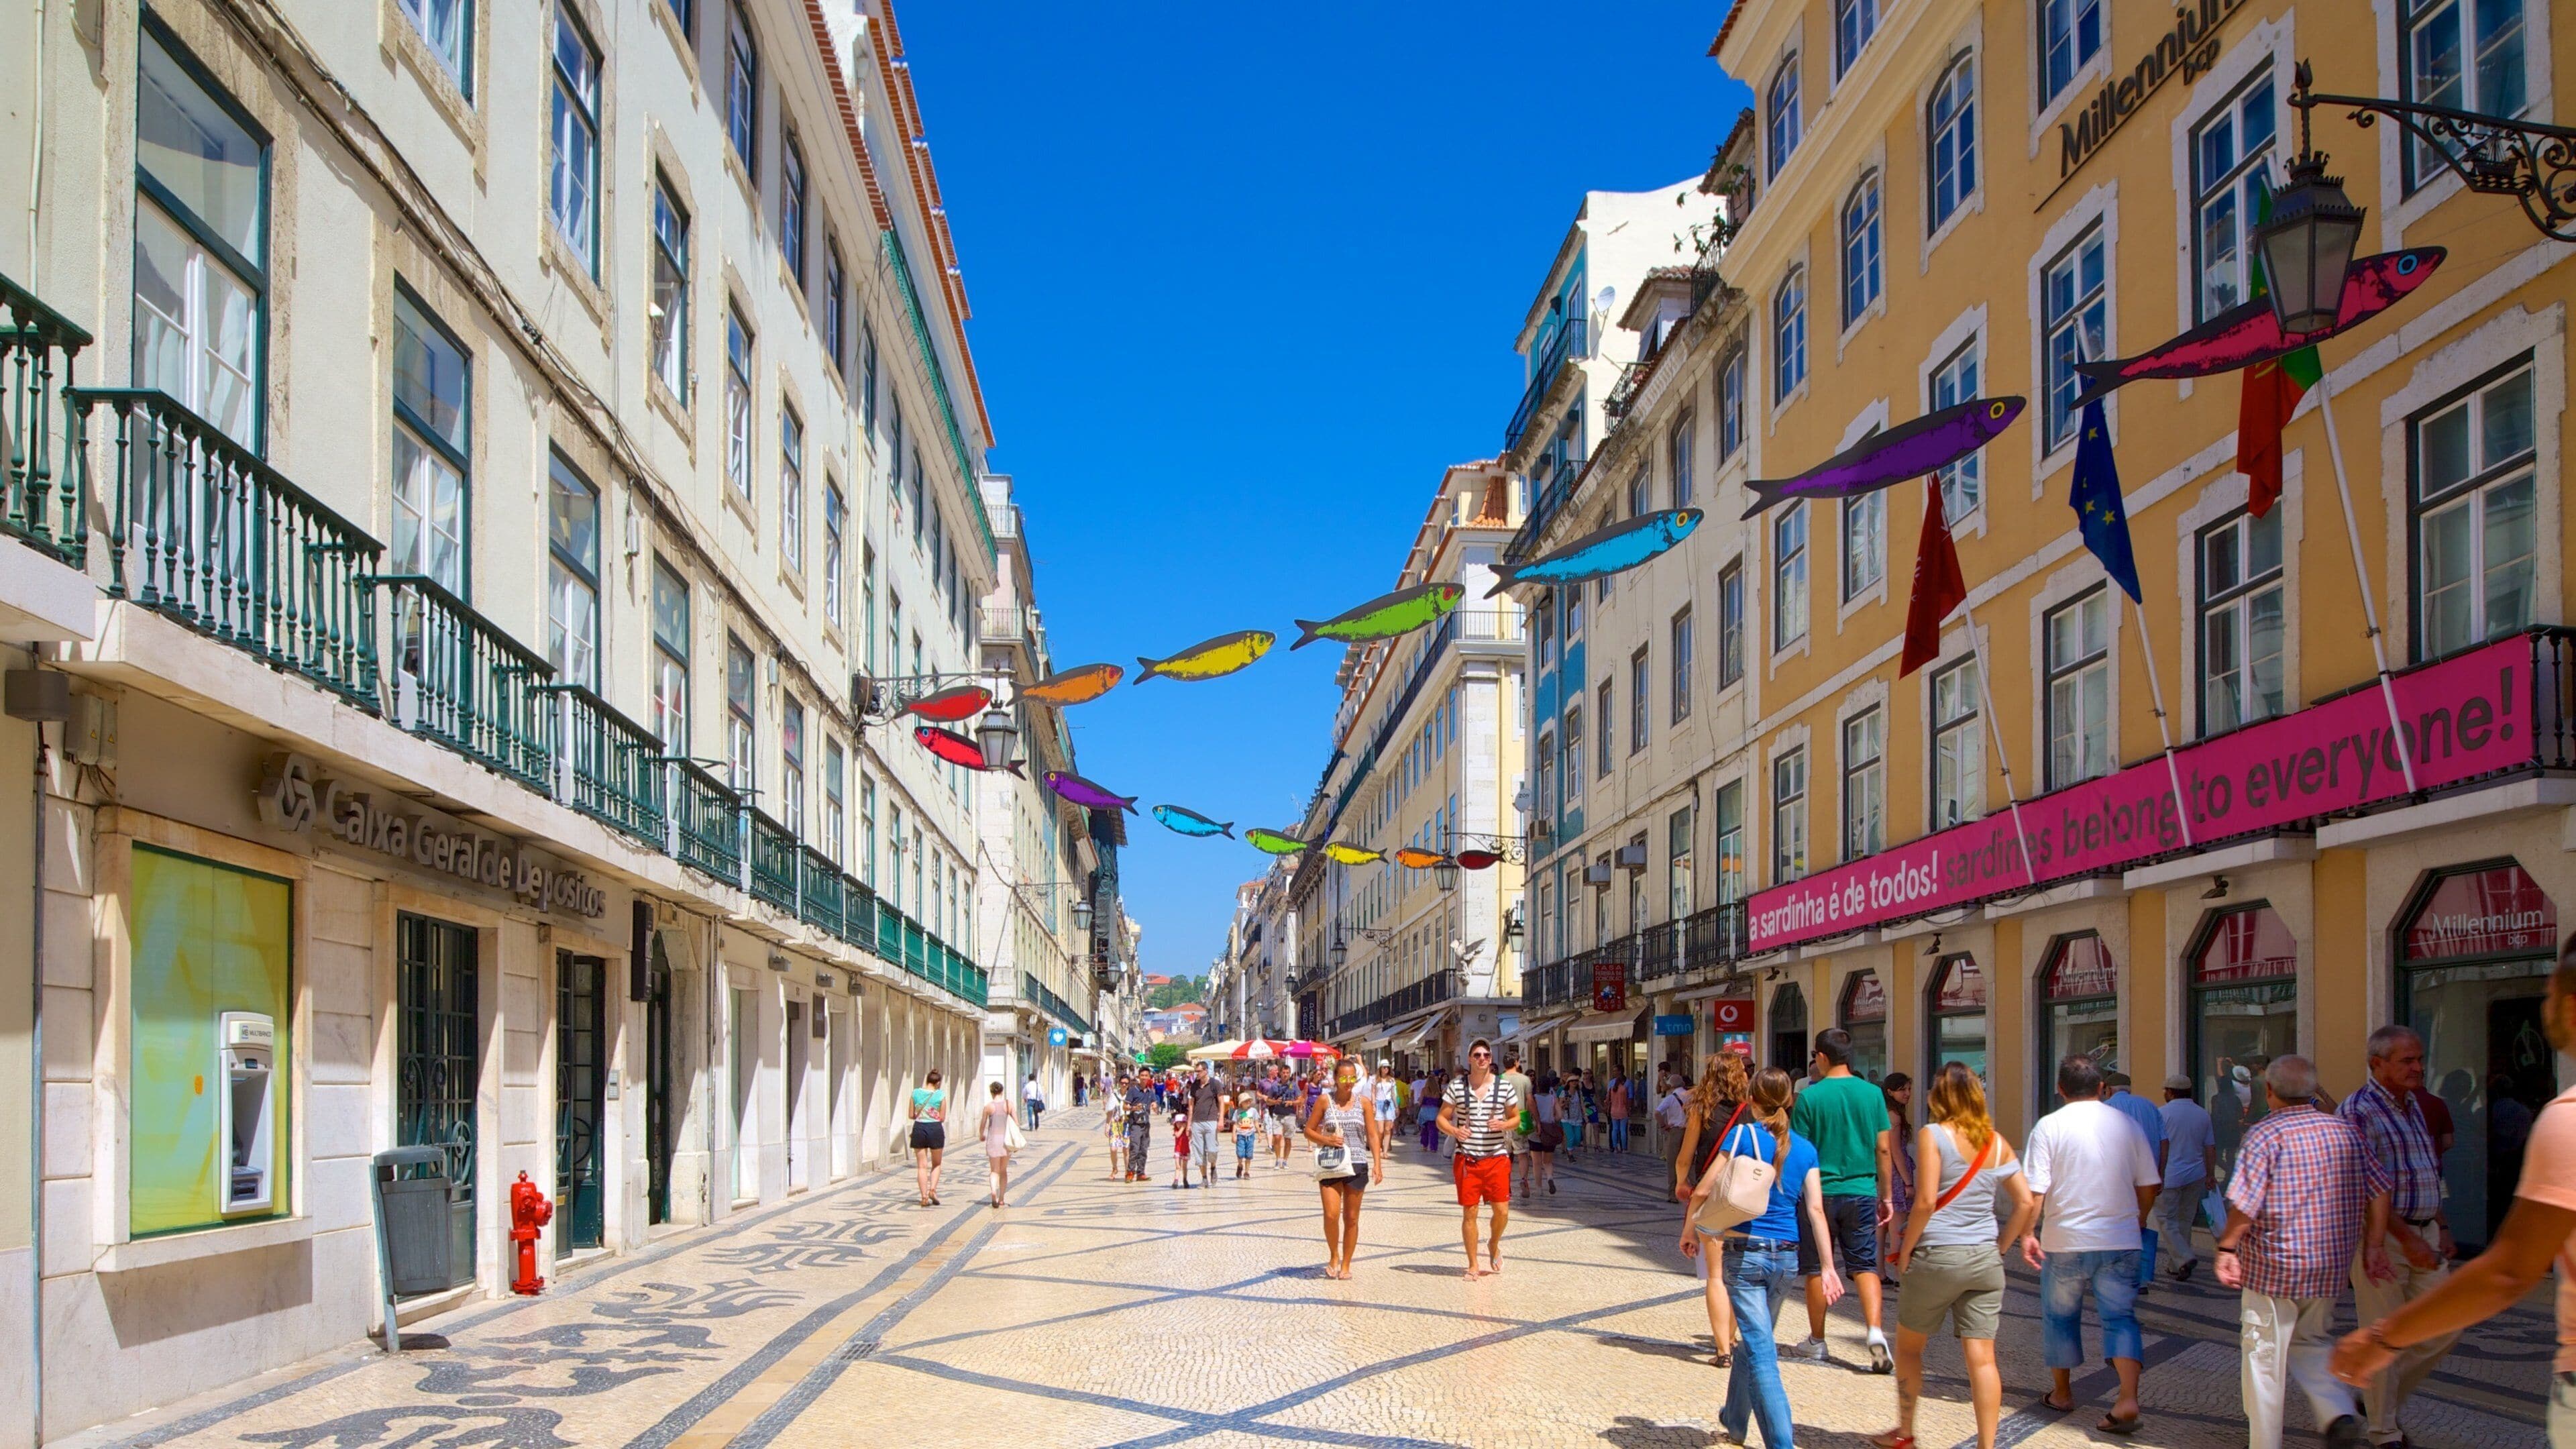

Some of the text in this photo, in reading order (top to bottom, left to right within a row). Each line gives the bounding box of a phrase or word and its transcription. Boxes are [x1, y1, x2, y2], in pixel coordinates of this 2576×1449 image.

[2183, 38, 2221, 87] bcp
[2058, 0, 2234, 178] Millenniu
[1750, 665, 2514, 941] a sardinha é de todos! sardines belong to everyone!
[325, 779, 407, 857] Caixa
[413, 814, 482, 880] Geral
[481, 840, 511, 890] de
[2430, 907, 2544, 940] Millennium
[2507, 933, 2528, 947] bcp
[1666, 1022, 1691, 1032] tmn
